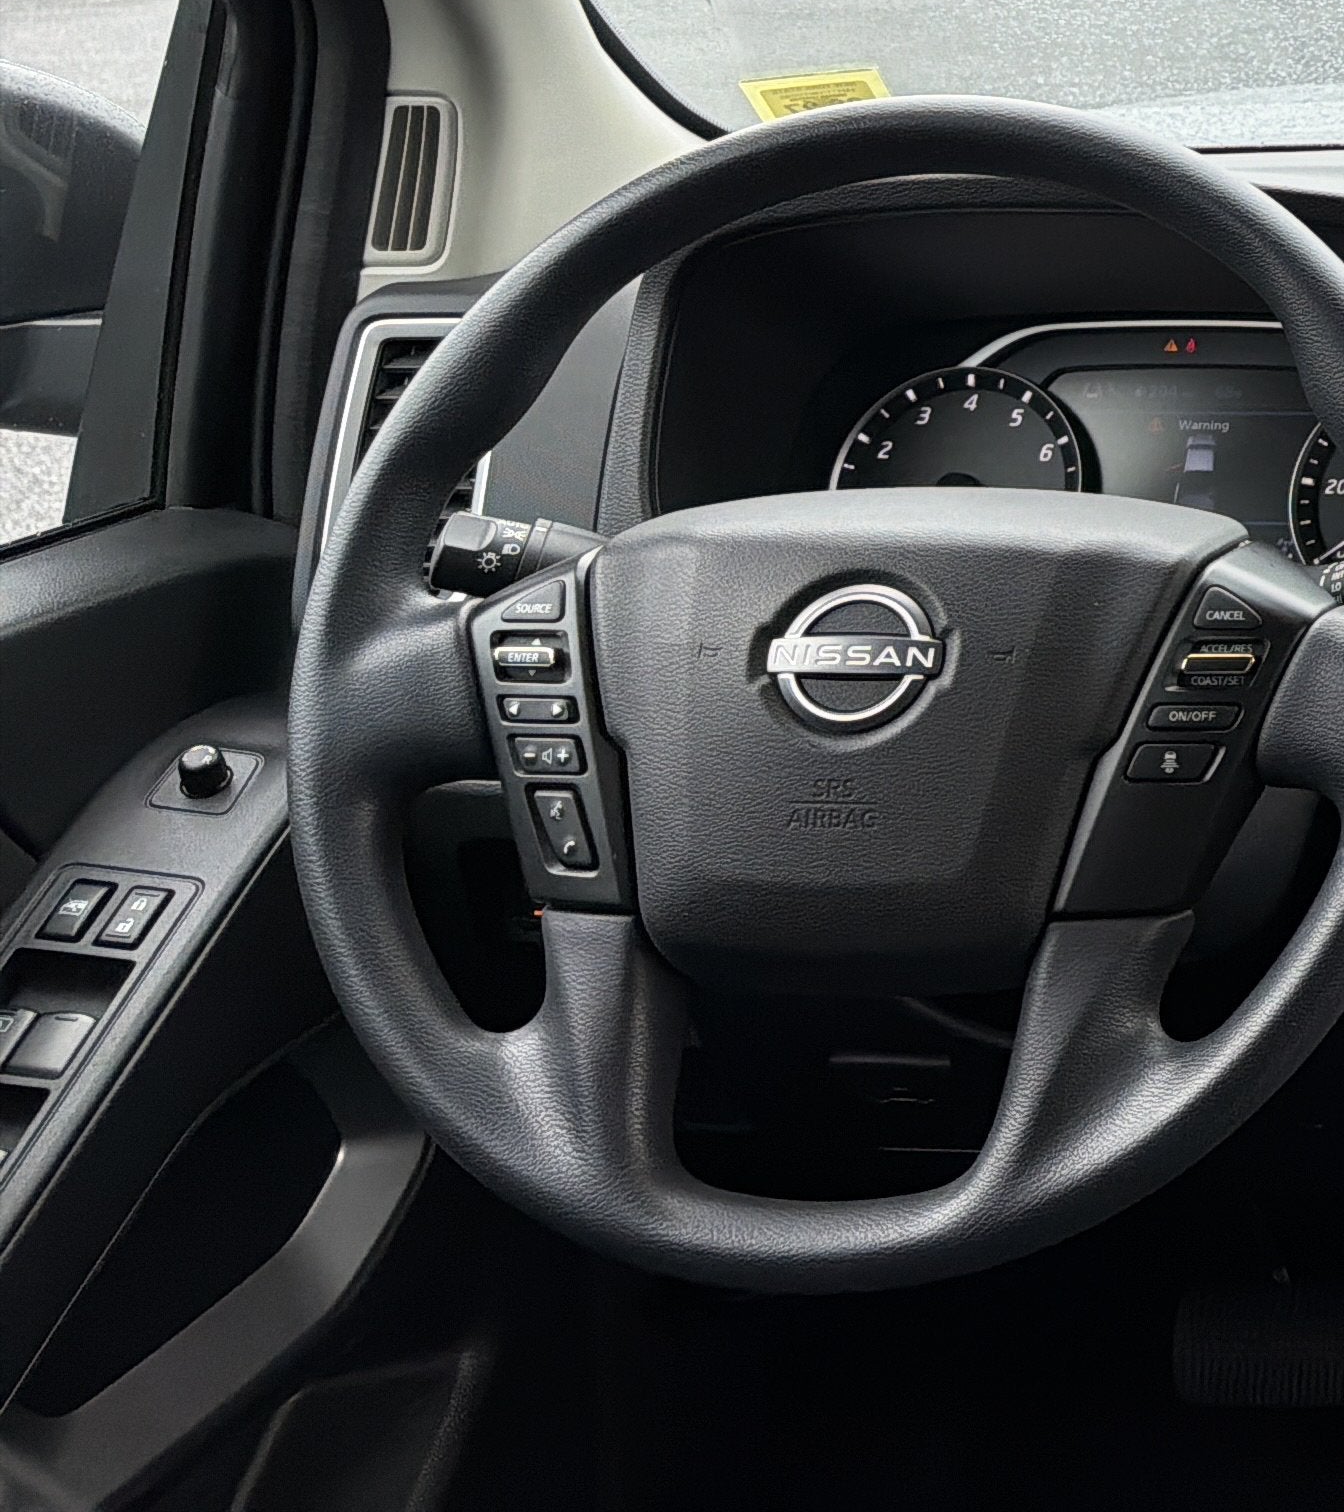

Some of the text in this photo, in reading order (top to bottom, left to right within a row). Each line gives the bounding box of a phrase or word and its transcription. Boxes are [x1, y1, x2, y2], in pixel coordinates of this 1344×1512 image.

[963, 393, 979, 412] 4
[914, 406, 932, 426] 3
[1008, 408, 1025, 427] 5
[1179, 419, 1230, 433] Warning
[877, 440, 893, 460] 2
[1039, 443, 1055, 462] 6
[514, 603, 553, 614] SOURCE
[1205, 610, 1246, 621] CANCEL
[507, 652, 539, 663] ENTER
[773, 643, 936, 668] NISSAN
[1199, 643, 1253, 653] ACCEL/RES
[1190, 675, 1245, 686] COAST/SET
[1168, 710, 1217, 722] ON/OFF
[811, 777, 857, 799] SRS
[786, 807, 880, 830] AIRBAG
